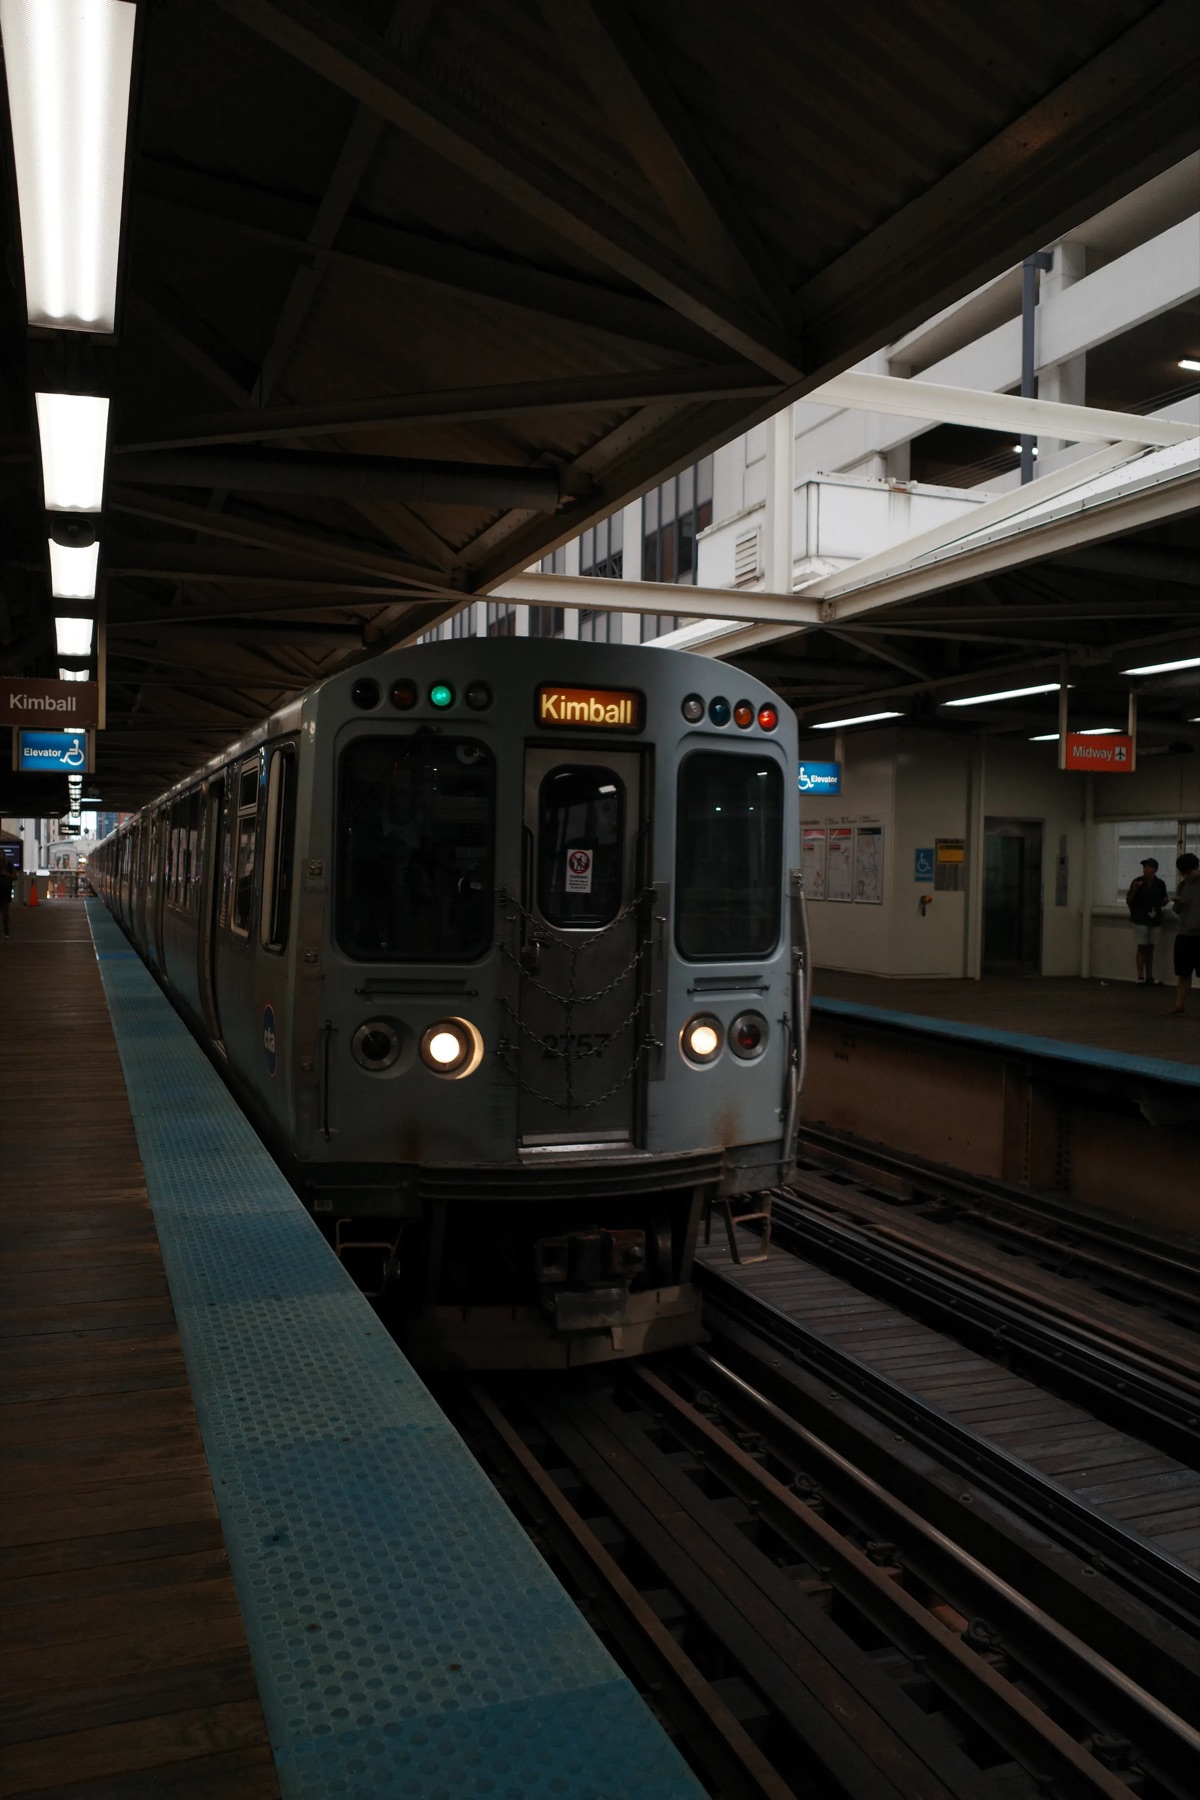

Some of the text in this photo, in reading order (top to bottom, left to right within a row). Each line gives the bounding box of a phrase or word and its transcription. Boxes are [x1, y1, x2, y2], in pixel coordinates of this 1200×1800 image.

[9, 693, 77, 712] Kimball
[541, 694, 632, 724] Kimball
[23, 747, 62, 757] Elevator
[1073, 746, 1112, 761] Midway
[542, 1033, 610, 1059] 2757
